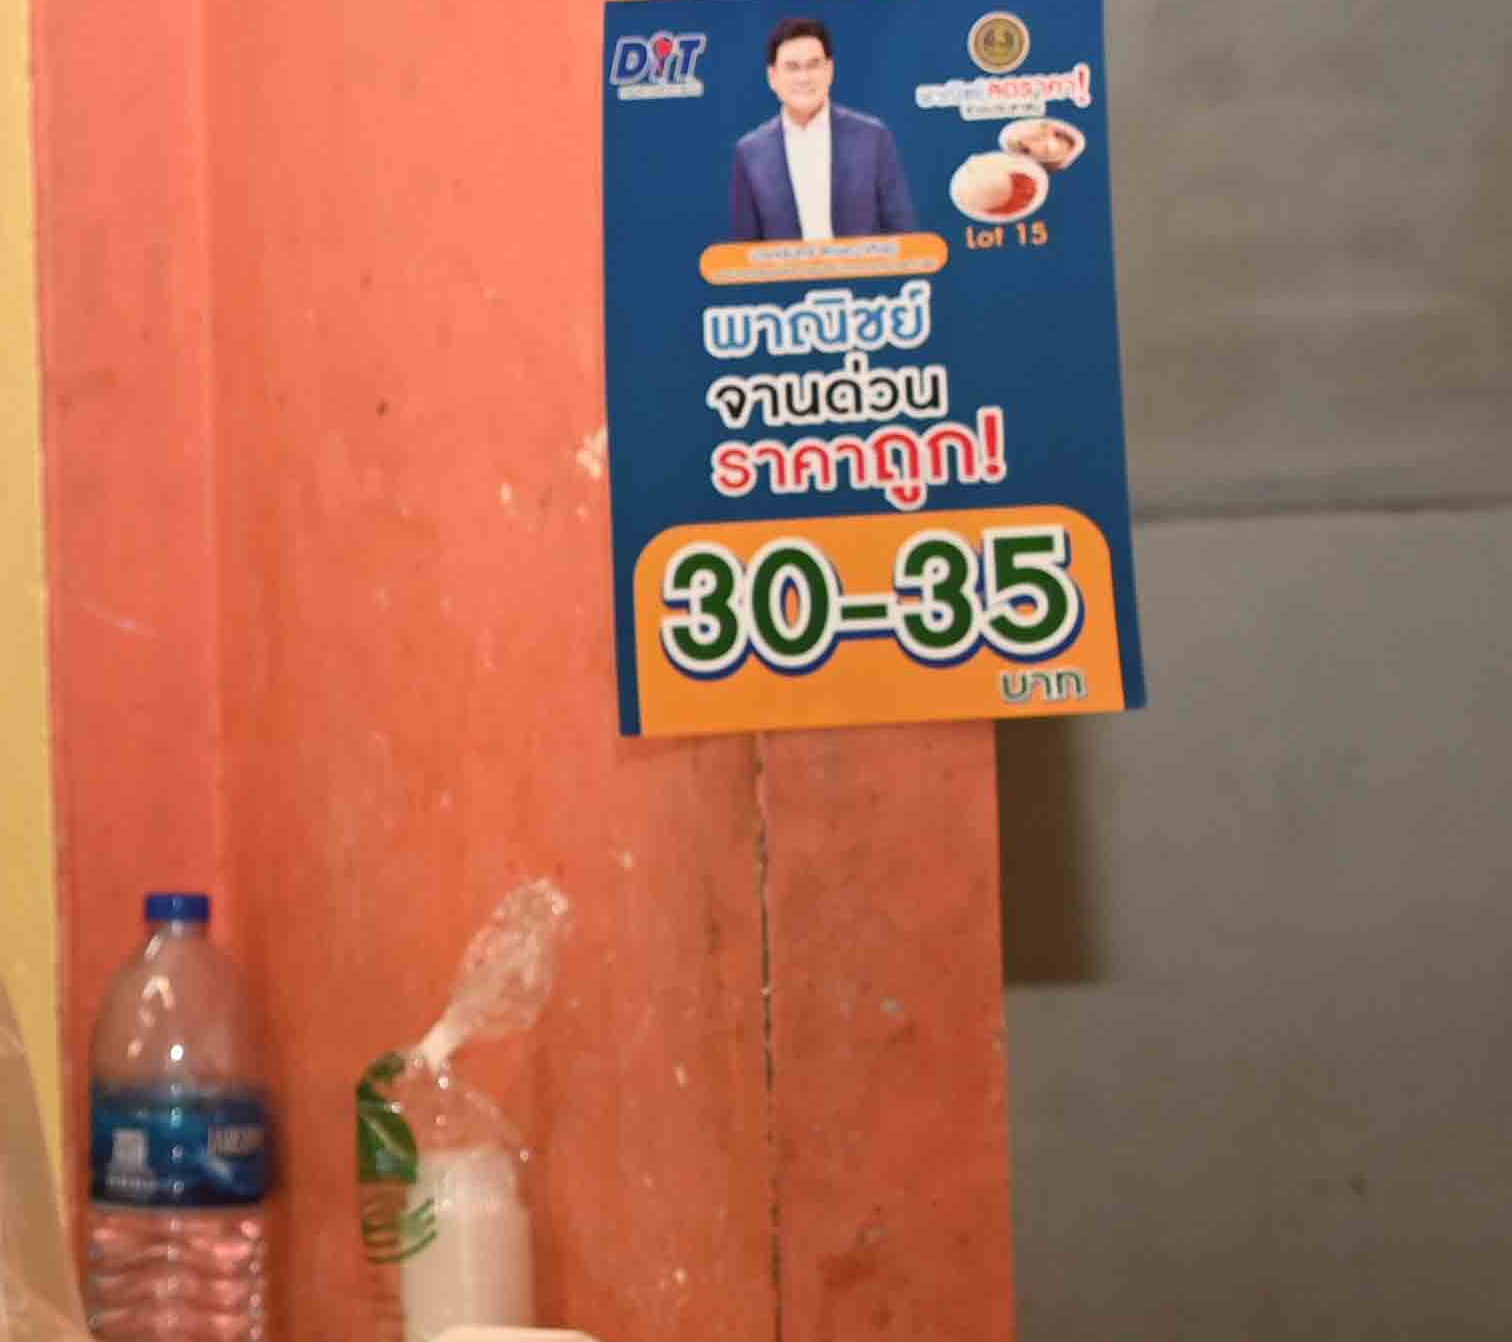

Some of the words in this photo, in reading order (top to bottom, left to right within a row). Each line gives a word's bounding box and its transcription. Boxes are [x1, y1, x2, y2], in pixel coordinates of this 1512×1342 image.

[611, 33, 706, 84] DIT
[1016, 220, 1048, 246] 15
[707, 281, 929, 353] พาณิชย์
[711, 356, 945, 425] จานด่วน
[714, 410, 1005, 508] ราคาถูก!
[663, 527, 1081, 677] 30-35
[1001, 669, 1085, 701] บาท
